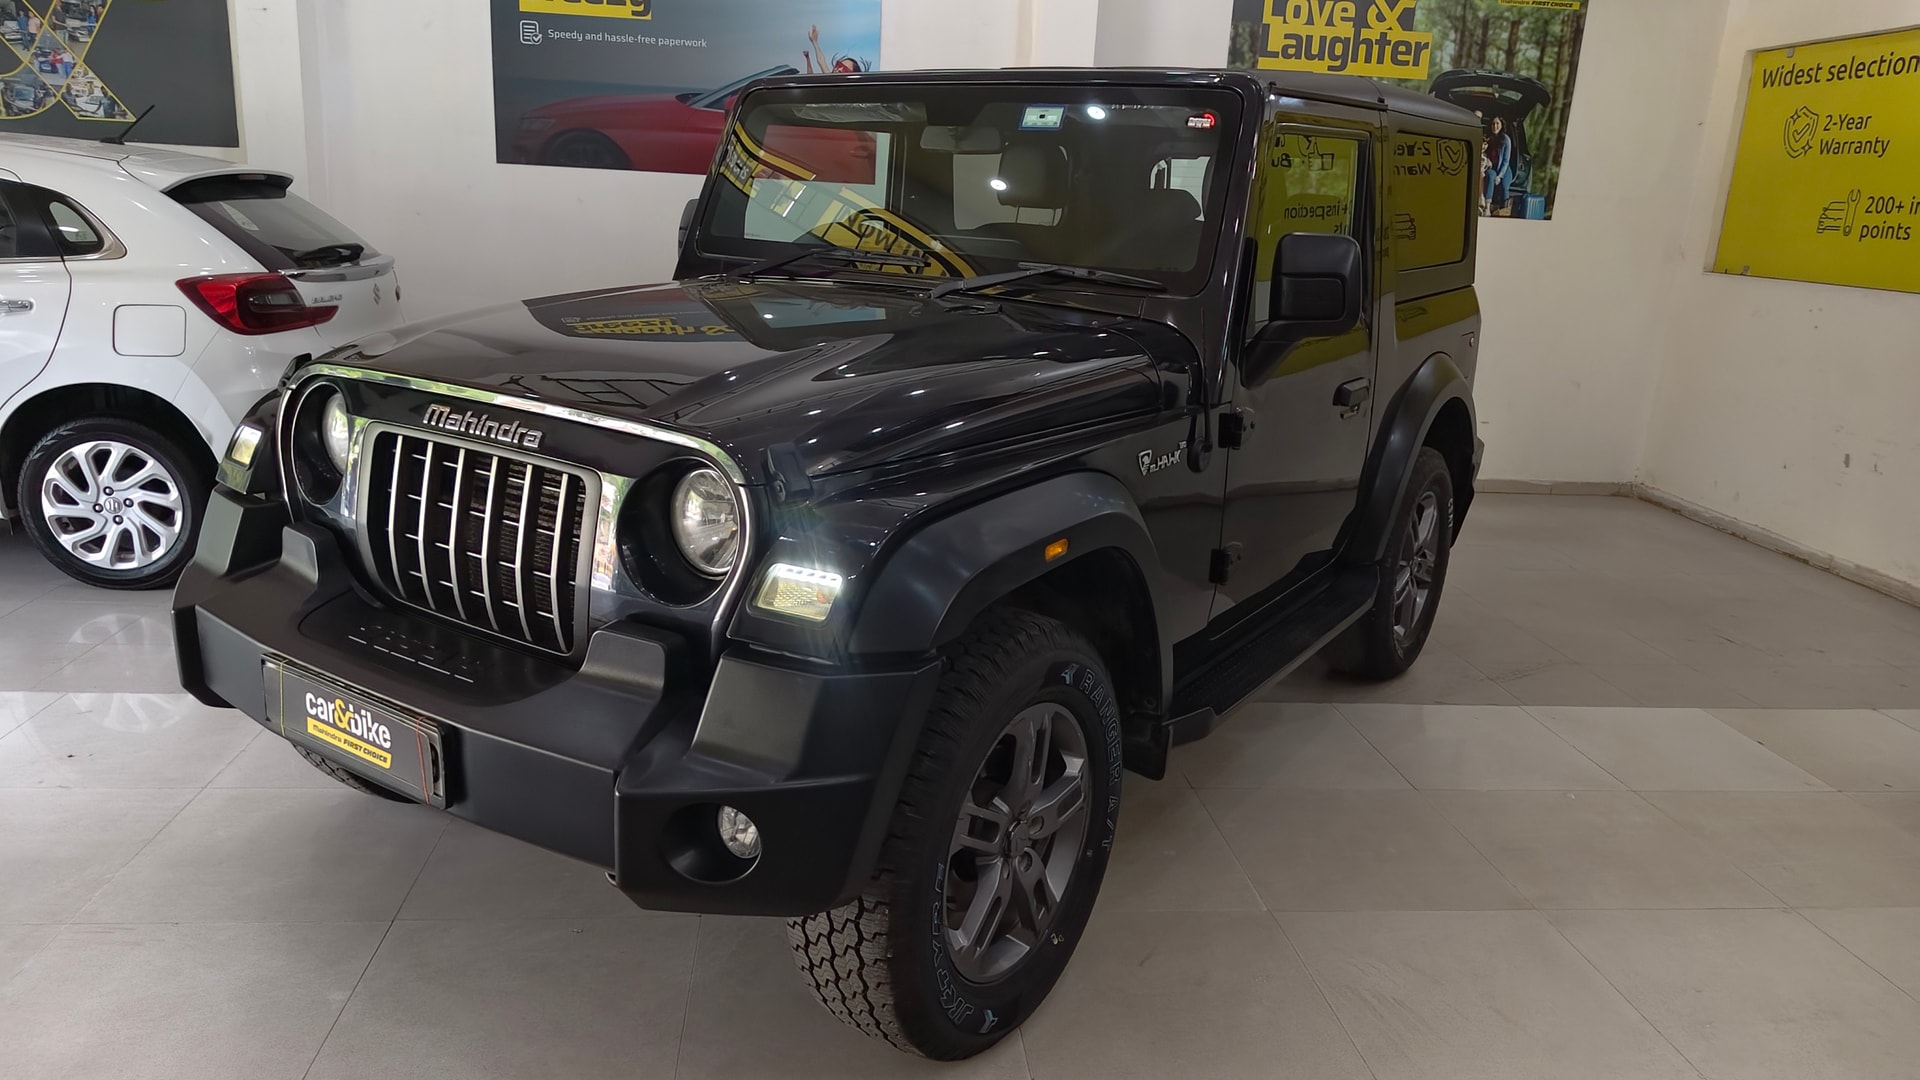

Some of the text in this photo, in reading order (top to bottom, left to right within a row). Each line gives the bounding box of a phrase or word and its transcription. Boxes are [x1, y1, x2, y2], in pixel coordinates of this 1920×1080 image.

[1262, 0, 1416, 31] Love &
[547, 28, 708, 48] Speedy and hassle-free paperwork
[1258, 23, 1430, 72] Laughter
[1761, 51, 1920, 89] Widest selection
[1822, 113, 1872, 132] 2-Year
[1818, 136, 1891, 158] Warranty
[1864, 195, 1905, 215] 200+
[1858, 220, 1912, 243] points
[422, 403, 543, 448] Mahindra
[305, 692, 392, 749] car&bike
[1079, 668, 1122, 787] RANGER
[343, 738, 363, 752] FIRST
[363, 747, 388, 763] CHOICE
